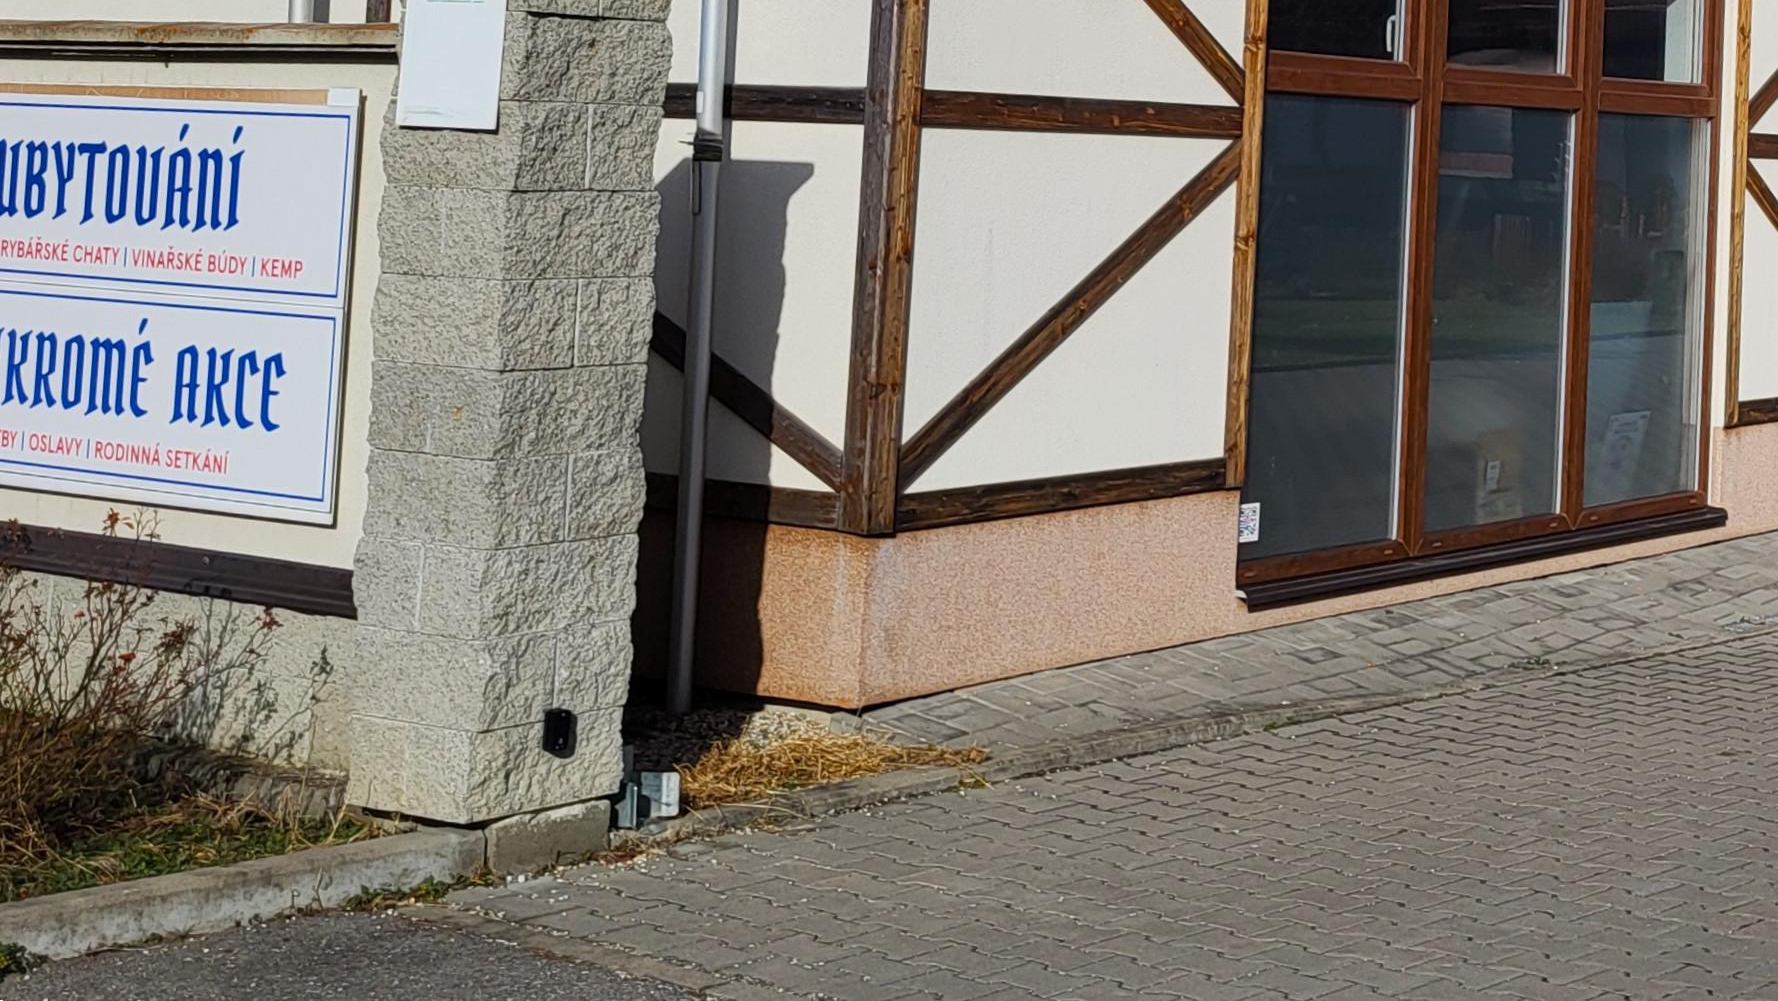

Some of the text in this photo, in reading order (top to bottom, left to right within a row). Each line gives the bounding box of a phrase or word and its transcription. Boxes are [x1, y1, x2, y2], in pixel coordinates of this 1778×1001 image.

[0, 123, 245, 232] UBYTOVÁNÍ
[1, 236, 304, 280] RYBÁŘSKÉ CHATY VINAŘSKÉ BÚDY KEMP
[0, 317, 287, 433] KROMÉ AKCE
[29, 433, 82, 459] OSLAVY
[95, 441, 161, 466] RODINNÁ
[165, 448, 229, 475] SETKÁNÍ
